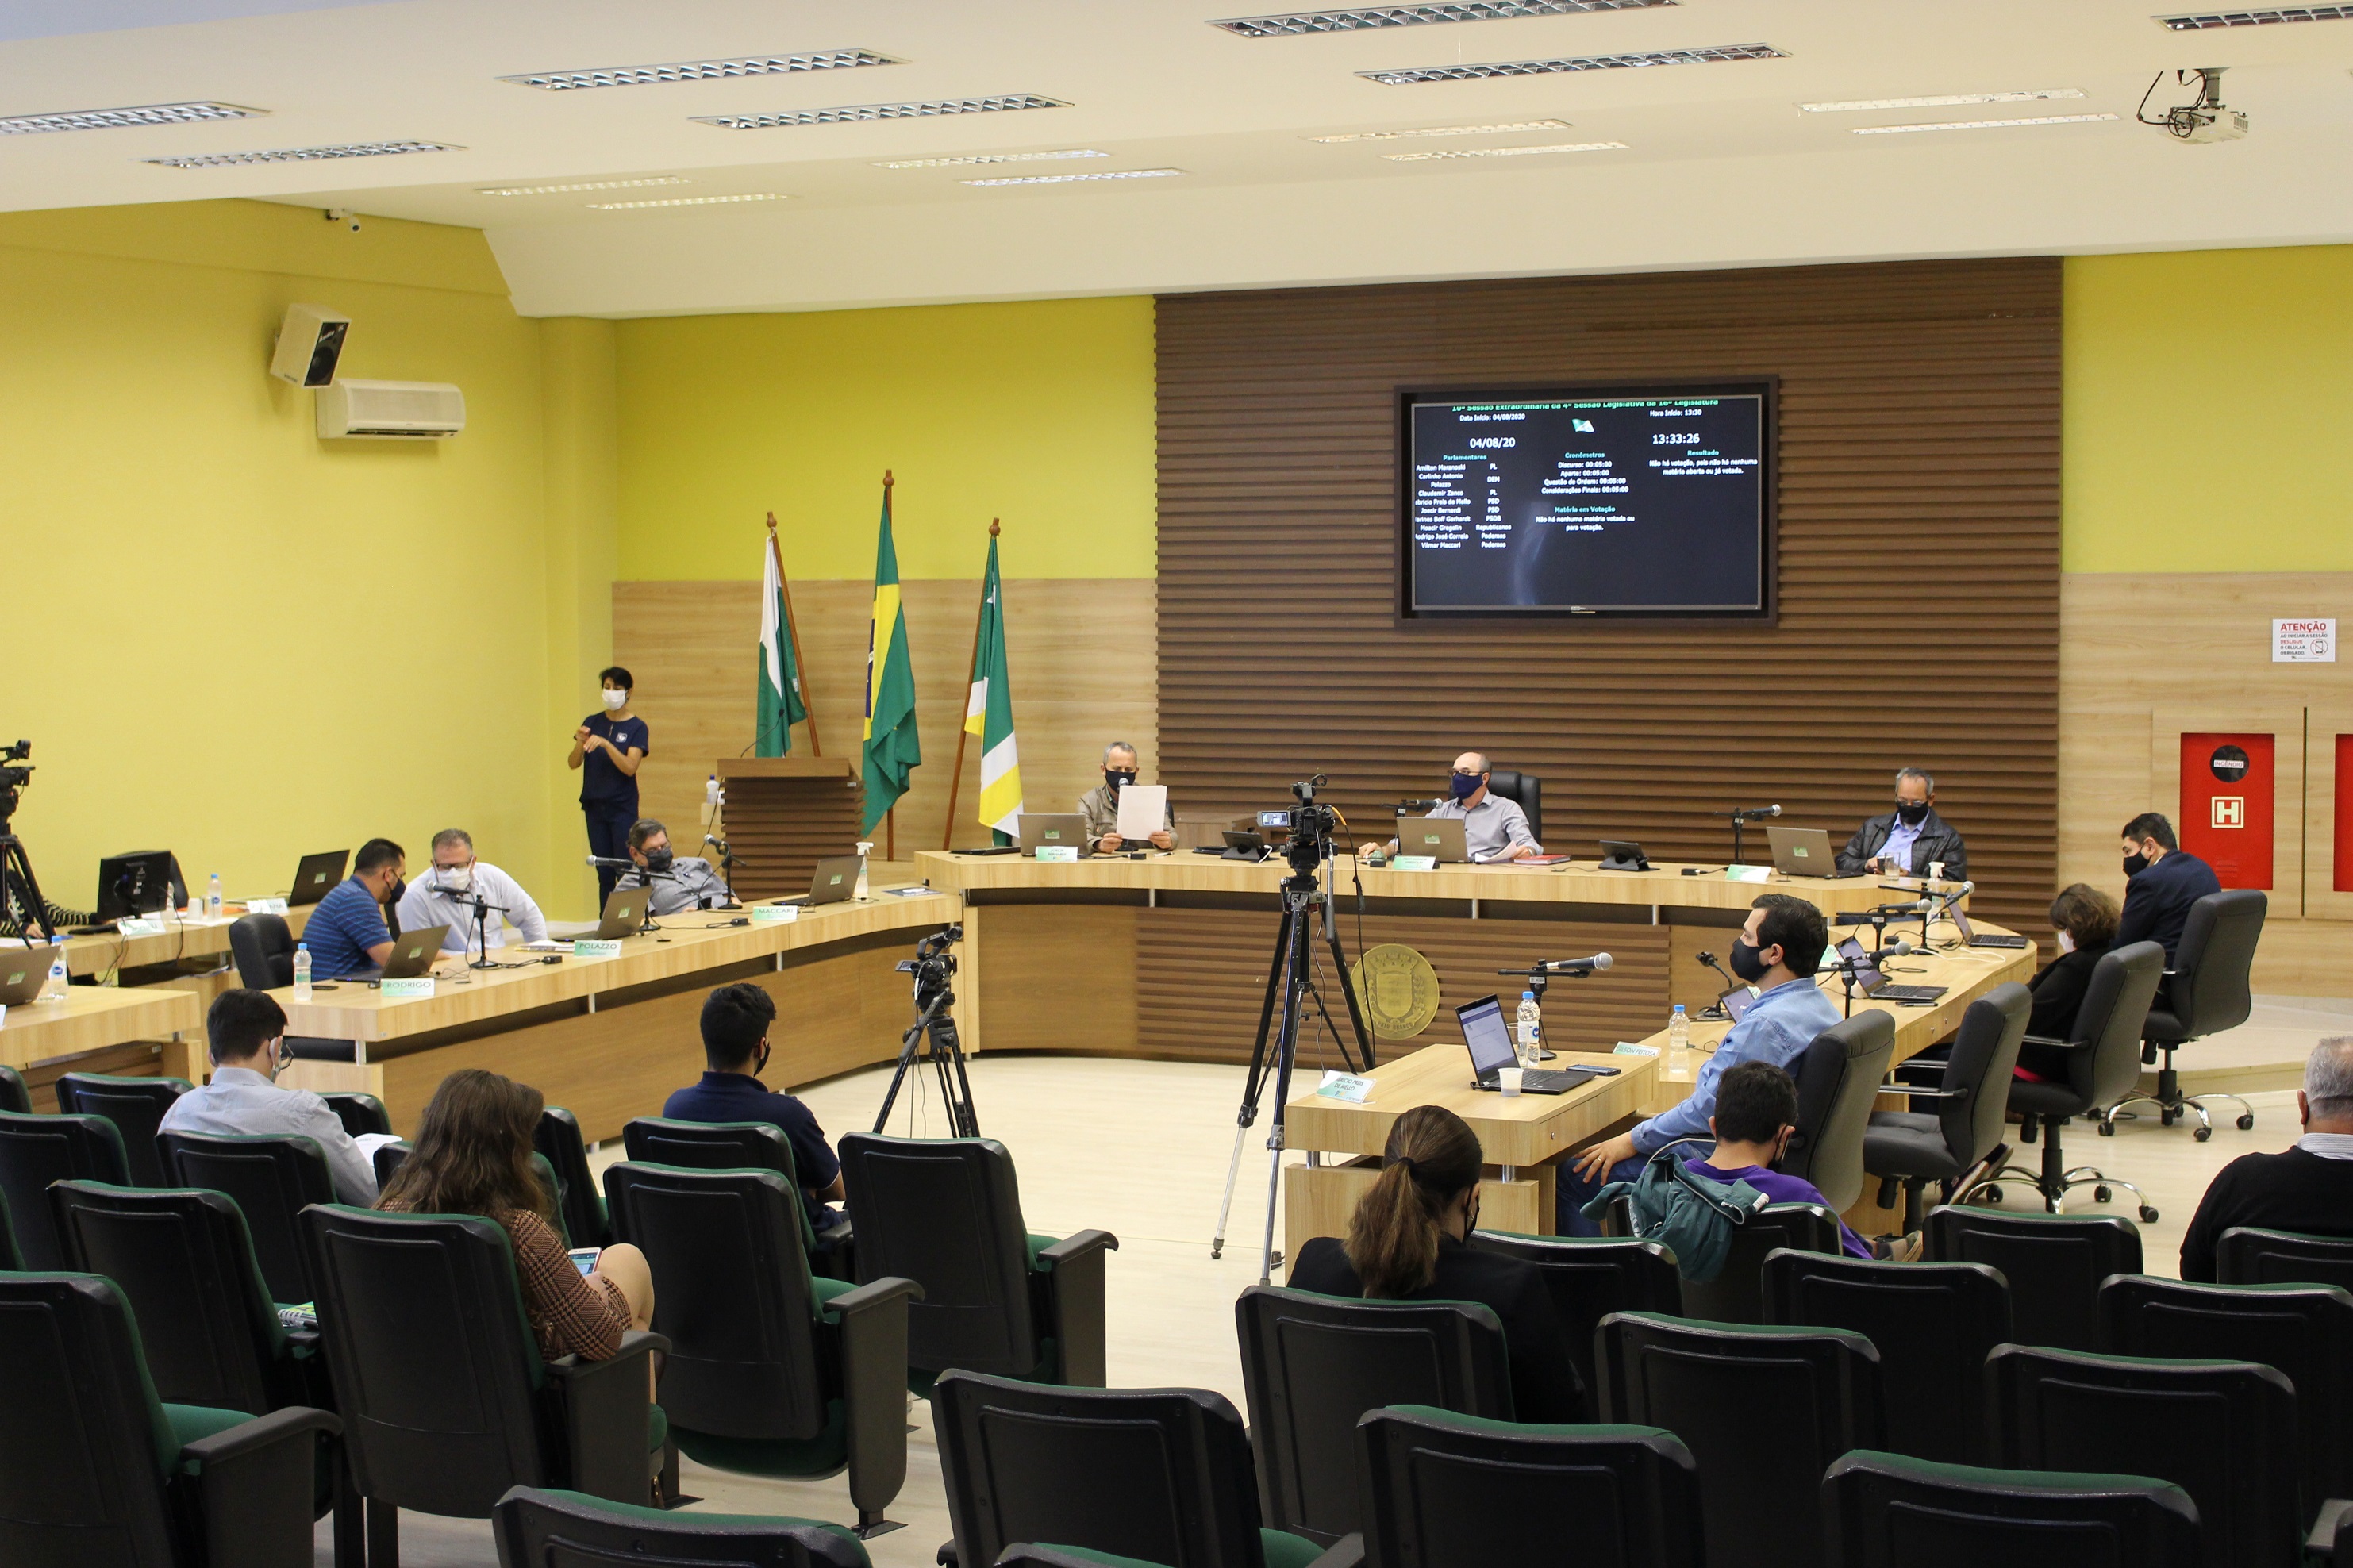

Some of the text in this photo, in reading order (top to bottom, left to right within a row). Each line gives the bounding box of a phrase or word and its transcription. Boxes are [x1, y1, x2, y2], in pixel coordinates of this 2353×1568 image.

[1470, 437, 1516, 449] 04/08/20
[1652, 433, 1700, 444] 13:33:26
[1439, 524, 1463, 532] Gregolin
[2280, 621, 2327, 633] ATENÇÃO
[2214, 759, 2243, 768] INCÊNDIO
[2217, 801, 2239, 823] H
[1636, 1048, 1656, 1057] FEITOSA
